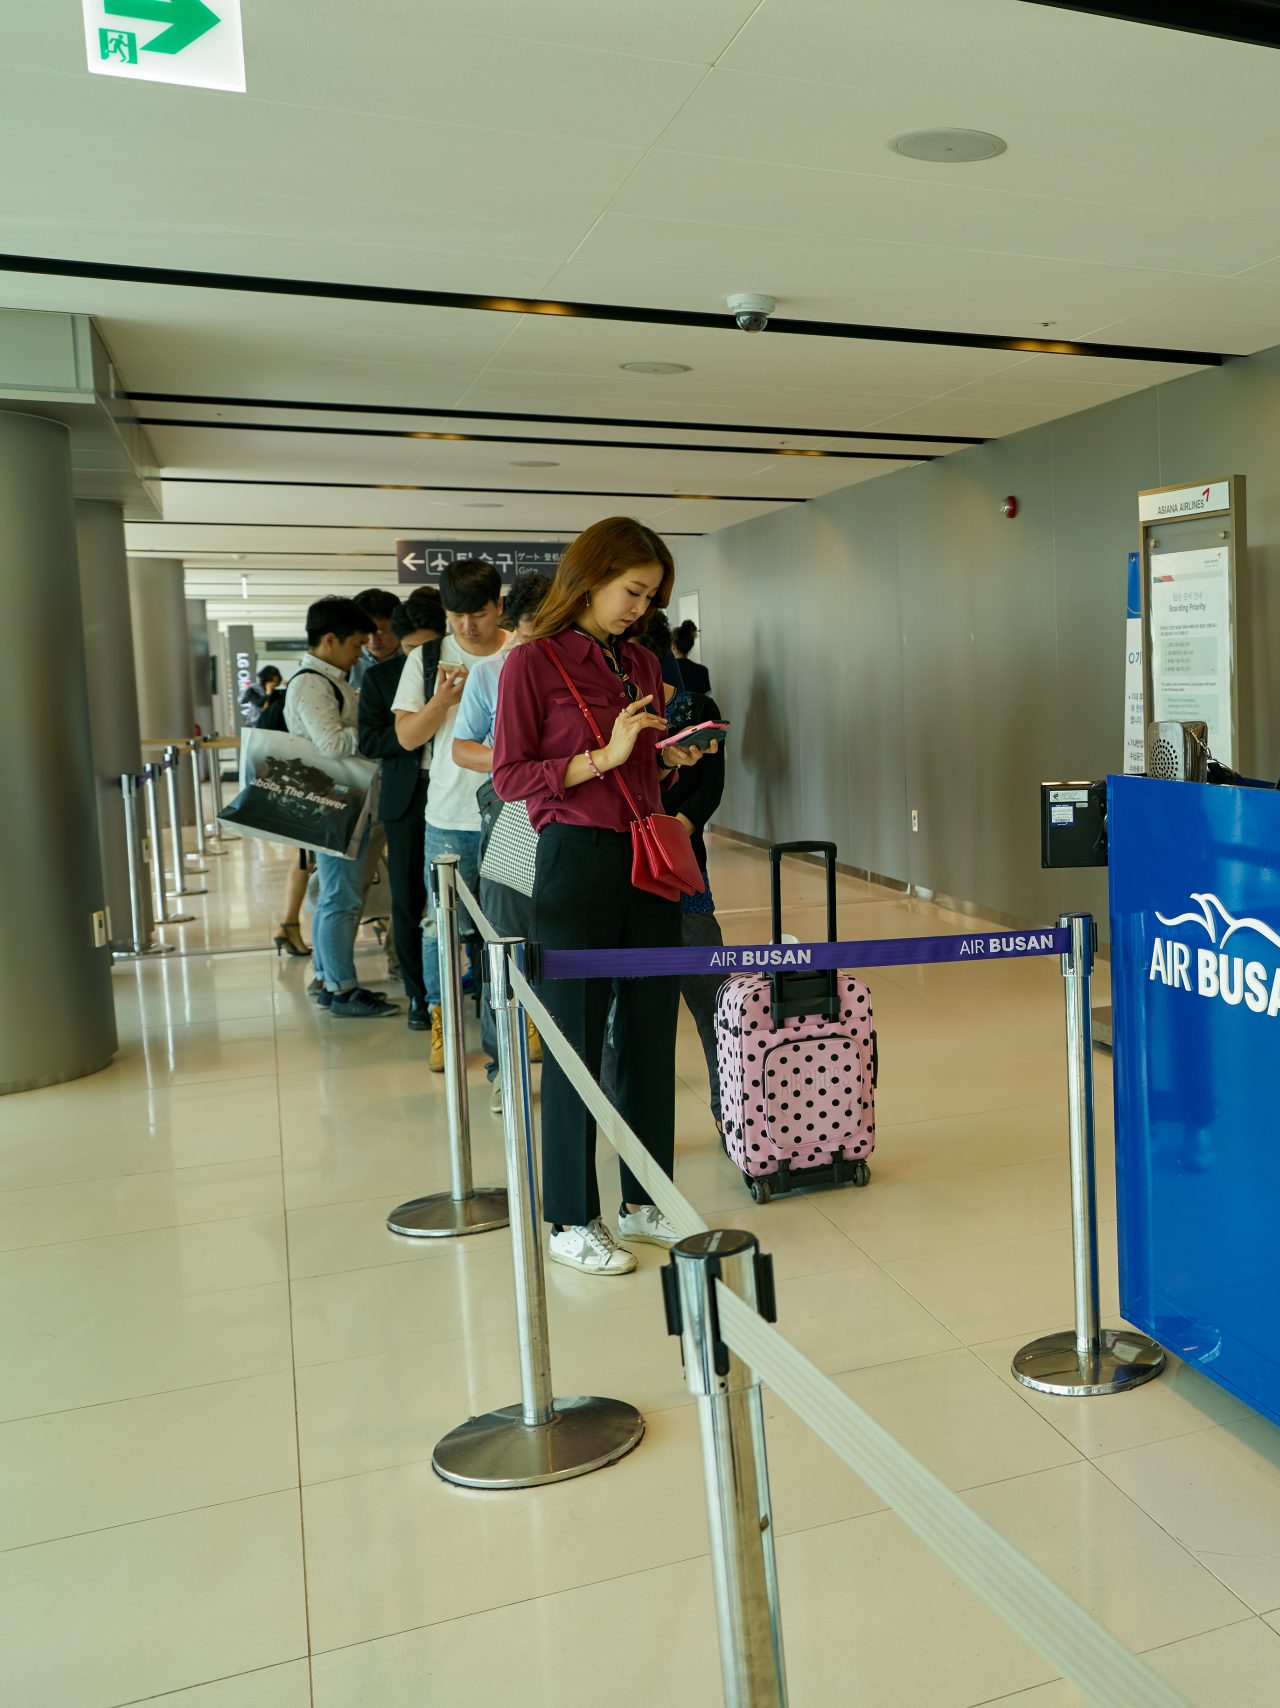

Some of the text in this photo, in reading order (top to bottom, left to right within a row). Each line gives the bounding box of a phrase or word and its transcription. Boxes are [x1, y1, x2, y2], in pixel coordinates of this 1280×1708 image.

[1157, 499, 1205, 516] ASIANA AIRLINES
[1190, 602, 1206, 612] Priority
[284, 785, 305, 800] The
[305, 791, 348, 811] Answer
[960, 934, 1054, 955] AIR BUSAN
[710, 949, 812, 967] AIR BUSAN
[1150, 937, 1192, 992] AIR
